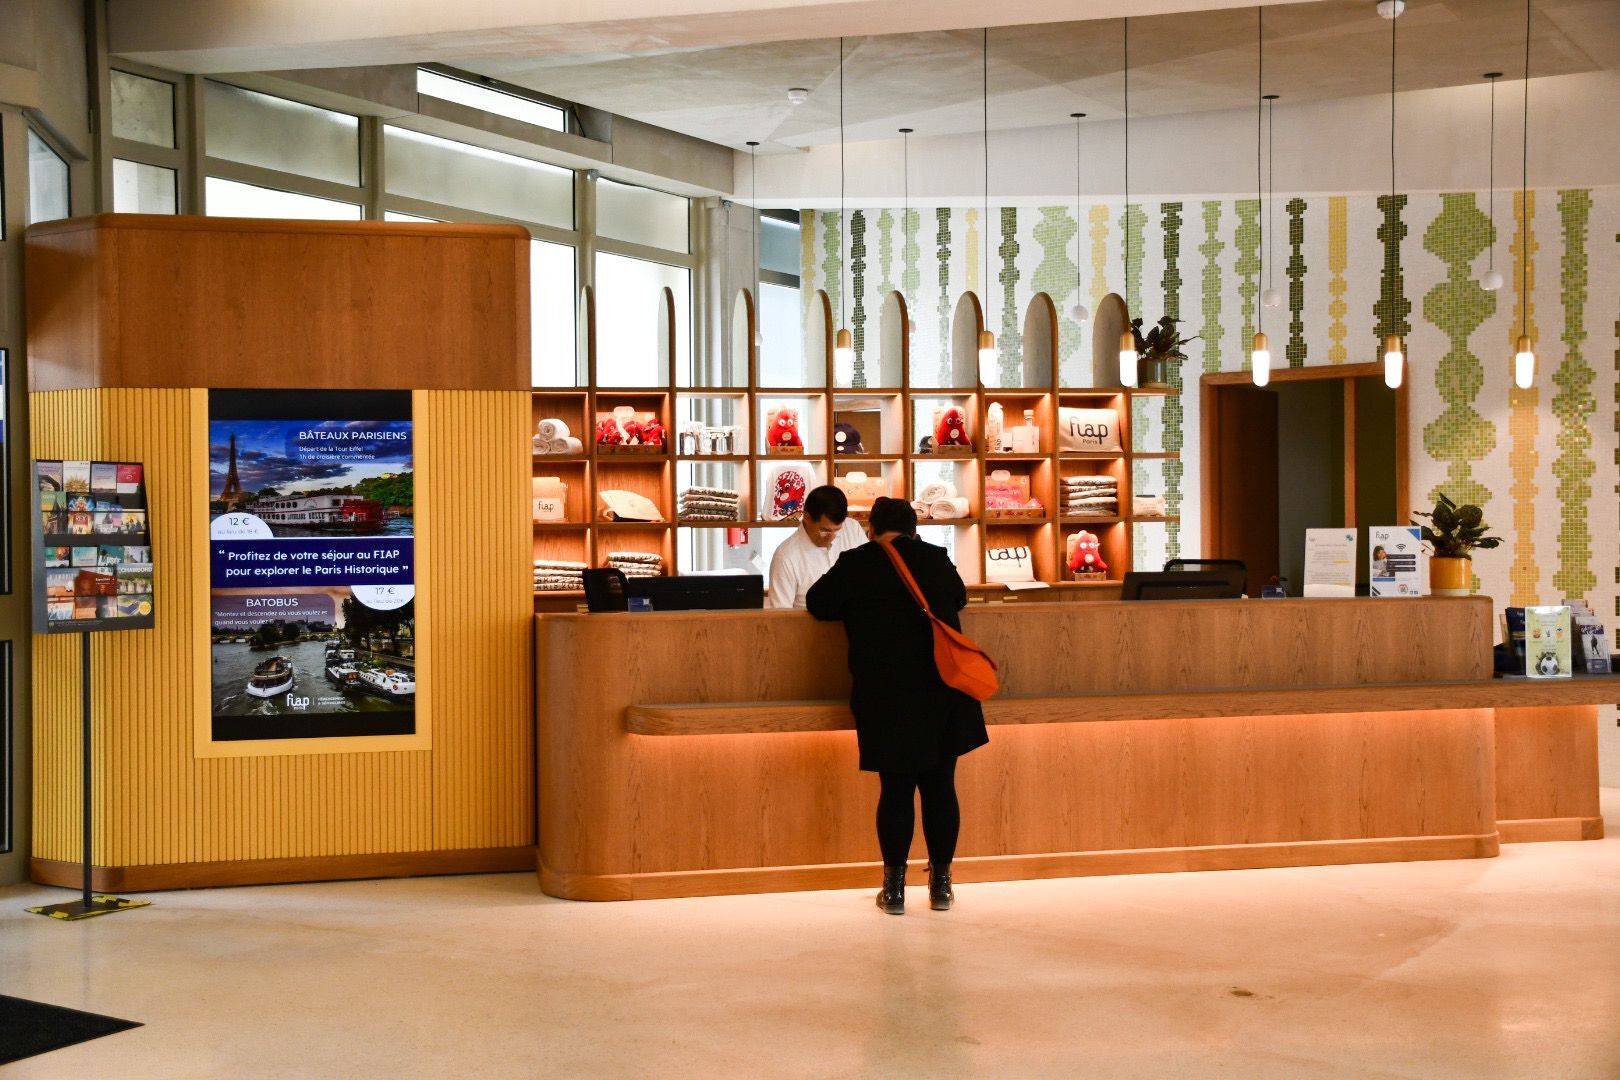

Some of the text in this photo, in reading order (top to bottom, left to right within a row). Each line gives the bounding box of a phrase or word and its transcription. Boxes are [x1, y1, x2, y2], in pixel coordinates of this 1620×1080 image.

[299, 430, 407, 440] BÂTEAUX PARISIENS
[1069, 416, 1109, 445] fiap
[299, 446, 318, 454] Départ
[538, 500, 555, 512] fiap
[229, 517, 250, 526] 12 €
[228, 551, 271, 561] Profitez
[273, 550, 287, 561] de
[290, 552, 319, 560] votre
[321, 550, 354, 562] séjour
[373, 550, 400, 559] FIAP
[226, 568, 252, 578] pour
[254, 566, 300, 577] explorer
[302, 565, 312, 575] le
[315, 565, 342, 575] Paris
[344, 564, 399, 576] Historique
[376, 587, 396, 595] 17 €
[246, 598, 299, 607] BATOBUS
[214, 619, 234, 627] quand
[286, 693, 310, 710] fiap
